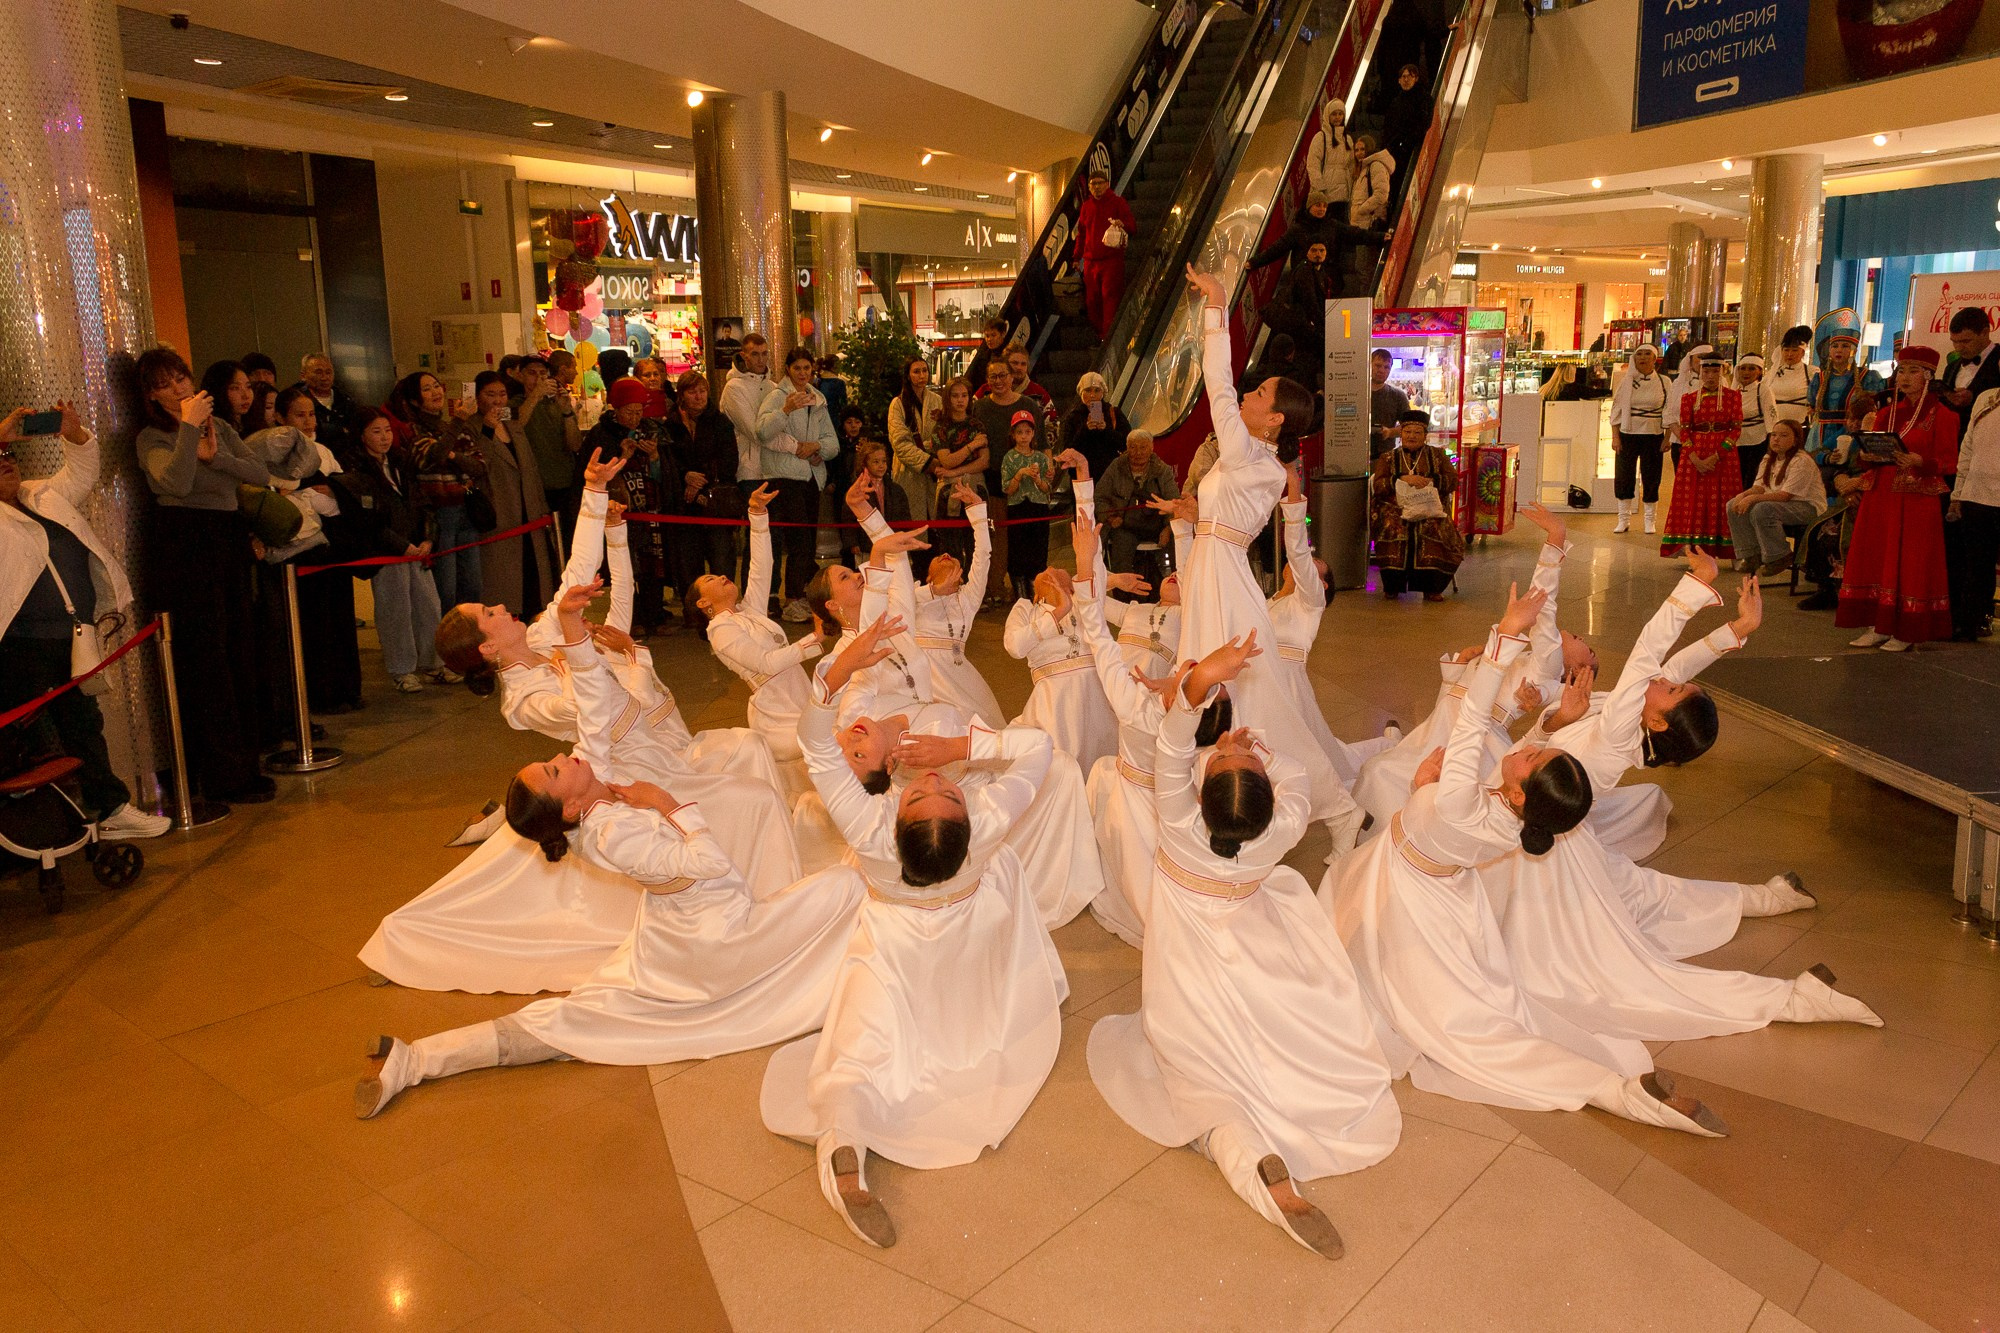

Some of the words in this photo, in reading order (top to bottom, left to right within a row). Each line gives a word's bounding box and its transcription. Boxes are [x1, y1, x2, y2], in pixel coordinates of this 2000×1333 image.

[1664, 4, 1777, 51] ПАРФЮМЕРИЯ
[1662, 60, 1673, 78] И
[1677, 33, 1777, 74] КОСМЕТИКА
[995, 232, 1017, 243] ARMANI
[1452, 263, 1477, 276] AMSUNG
[1516, 264, 1537, 274] TOMMY
[1542, 265, 1565, 275] HILFIGER
[1648, 267, 1667, 276] TOMMY
[1955, 293, 1987, 301] ФАБРИКА
[1341, 309, 1351, 339] 1
[1328, 351, 1334, 359] 4
[1328, 372, 1334, 381] 3
[1328, 393, 1334, 402] 2
[1327, 439, 1334, 447] -1
